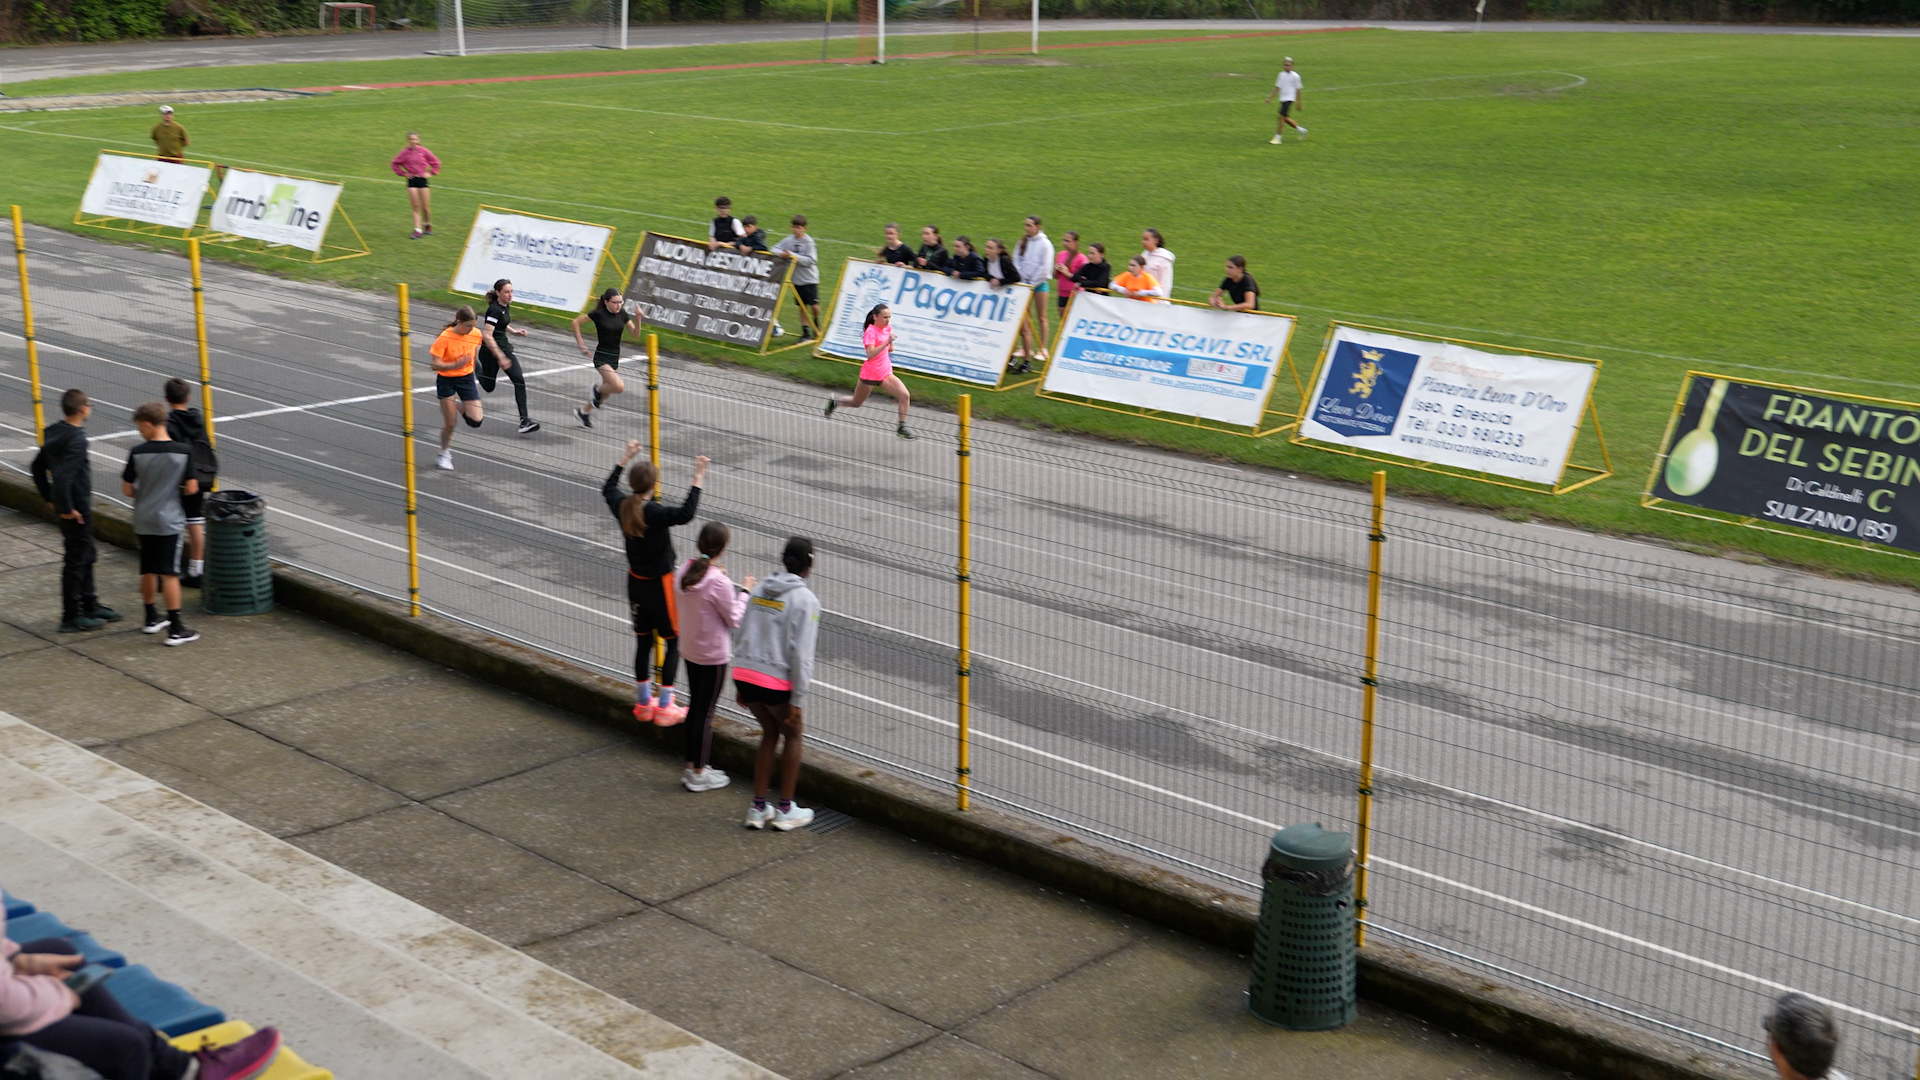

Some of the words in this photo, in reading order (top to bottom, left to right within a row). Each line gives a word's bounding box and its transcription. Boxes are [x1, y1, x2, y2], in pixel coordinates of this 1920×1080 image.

[492, 227, 547, 254] Far-Med
[546, 236, 595, 261] Sebina
[653, 240, 706, 265] NUOVA
[706, 251, 775, 277] GESTIONE
[893, 271, 1013, 322] Pagani
[695, 314, 762, 342] TRATTORIA
[1072, 318, 1165, 347] PEZZOTTI
[1167, 333, 1230, 355] SCAVI
[1234, 342, 1273, 362] SRL
[1114, 355, 1126, 365] E
[1124, 356, 1174, 373] STRADE
[1418, 376, 1479, 400] Pizzeria
[1479, 385, 1518, 405] Leon
[1520, 391, 1568, 413] D'Oro
[1436, 421, 1468, 438] 030
[1452, 403, 1513, 426] Brescia
[1738, 427, 1809, 468] DEL
[1785, 476, 1804, 493] Di
[1867, 488, 1897, 513] C
[1762, 500, 1857, 533] SULZANO
[1857, 518, 1898, 544] (BS)
